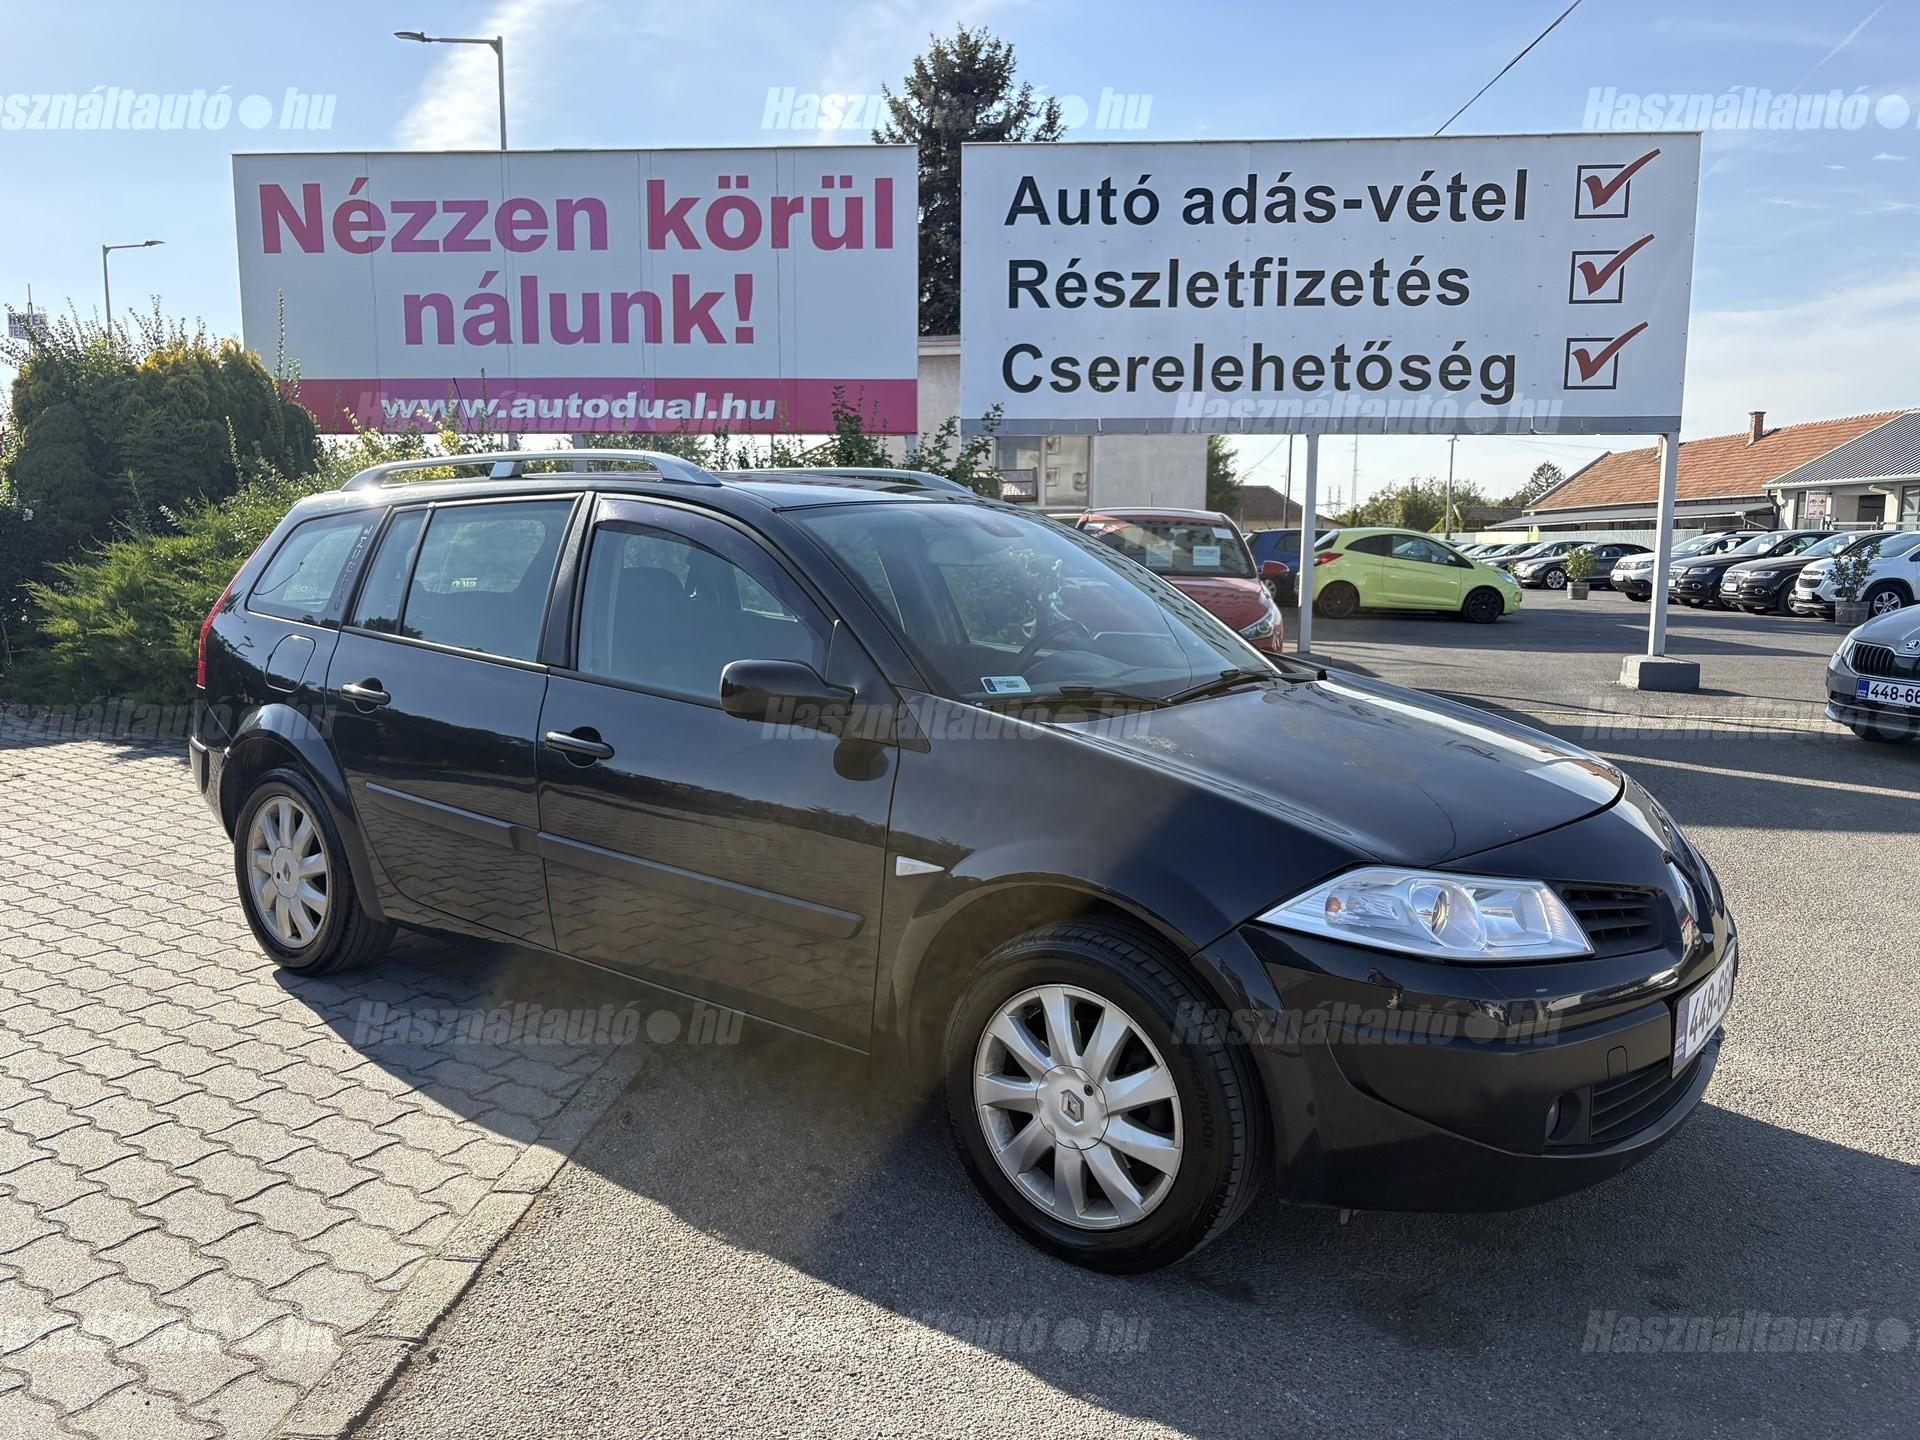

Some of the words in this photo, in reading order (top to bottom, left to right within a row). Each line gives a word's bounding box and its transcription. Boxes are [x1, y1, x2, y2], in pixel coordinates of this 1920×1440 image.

[259, 176, 609, 255] Nézzen
[647, 175, 894, 251] körül
[1005, 174, 1160, 226] Autó
[1182, 168, 1528, 226] adás-vétel
[403, 270, 754, 346] nálunk!
[1008, 255, 1470, 309] Részletfizetés
[1002, 339, 1516, 405] Cserelehetőség
[380, 391, 777, 420] www.autodual.hu
